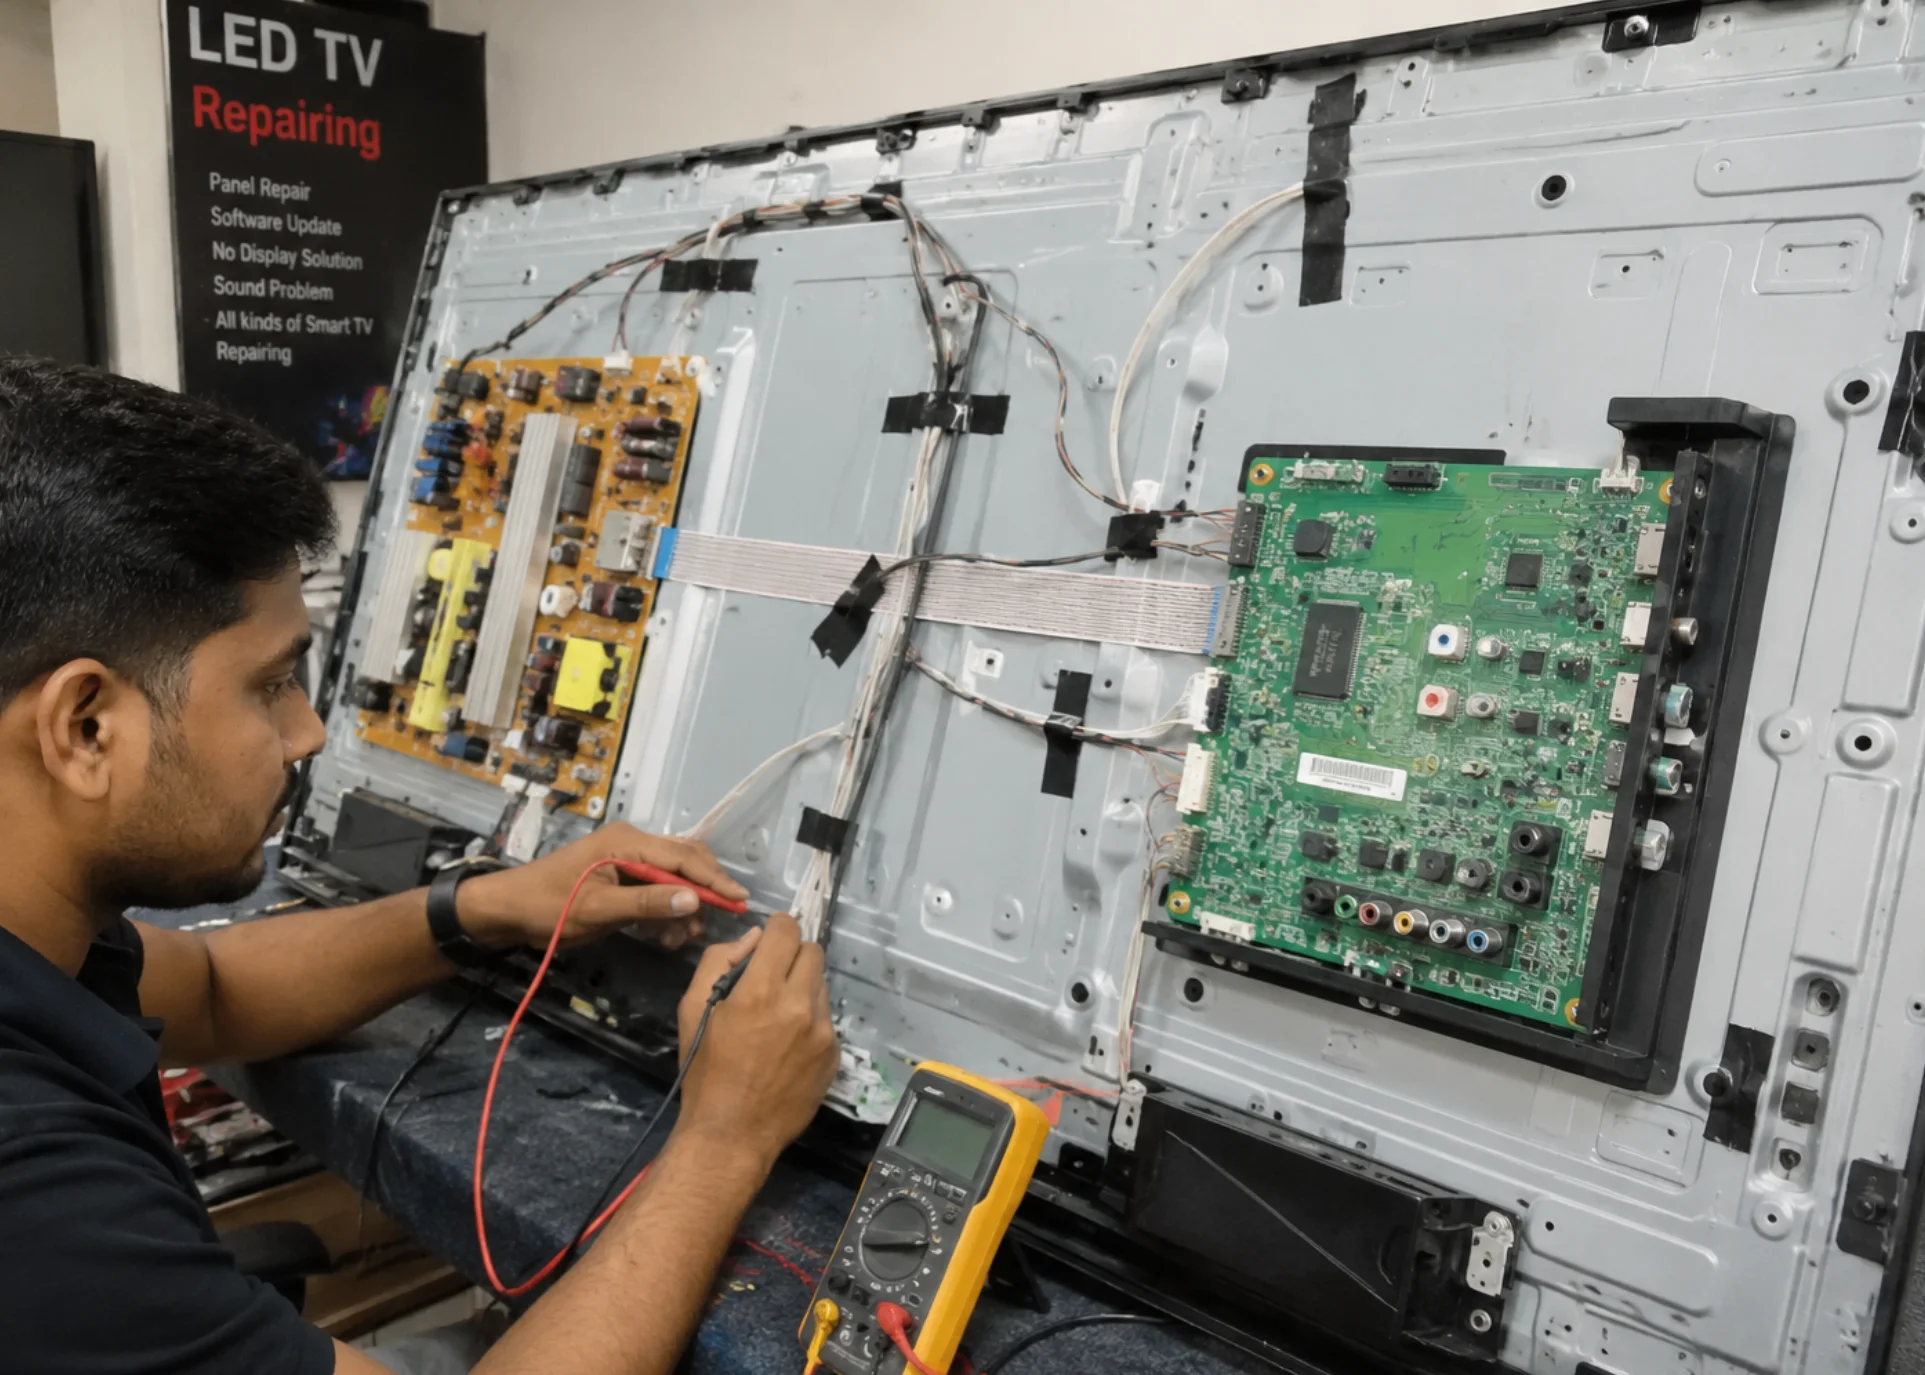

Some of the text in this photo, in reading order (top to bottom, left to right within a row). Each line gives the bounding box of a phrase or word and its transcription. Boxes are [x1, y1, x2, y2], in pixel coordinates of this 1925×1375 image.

[188, 6, 383, 87] LED TV
[193, 85, 381, 160] Repairing
[210, 172, 310, 204] Panel Repair
[211, 206, 342, 236] Software Update
[213, 241, 362, 269] No Display Solution
[214, 275, 333, 300] Sound Problem
[216, 311, 373, 334] All kinds of Smart TV
[217, 341, 291, 366] Repairing
